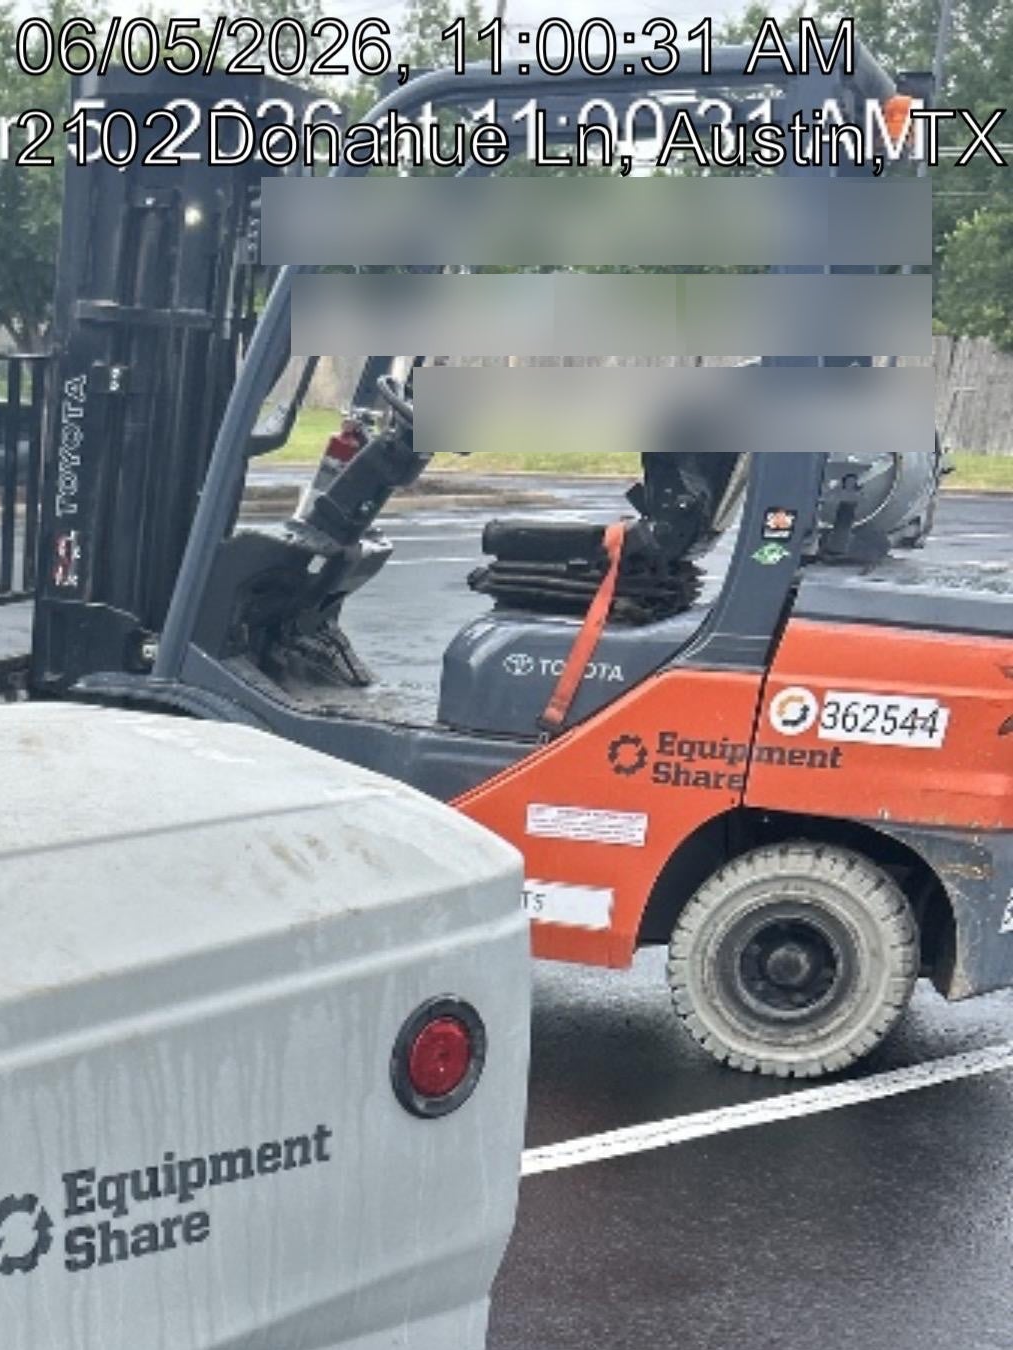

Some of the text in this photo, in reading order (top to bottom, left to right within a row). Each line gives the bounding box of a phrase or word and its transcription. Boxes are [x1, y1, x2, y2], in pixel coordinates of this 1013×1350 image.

[54, 373, 88, 518] TOYOTA
[539, 658, 625, 683] TOOTA
[820, 700, 940, 739] 362544
[655, 731, 844, 769] Equipment
[651, 760, 746, 792] Share
[61, 1123, 333, 1219] Equipment
[64, 1209, 211, 1273] Share
